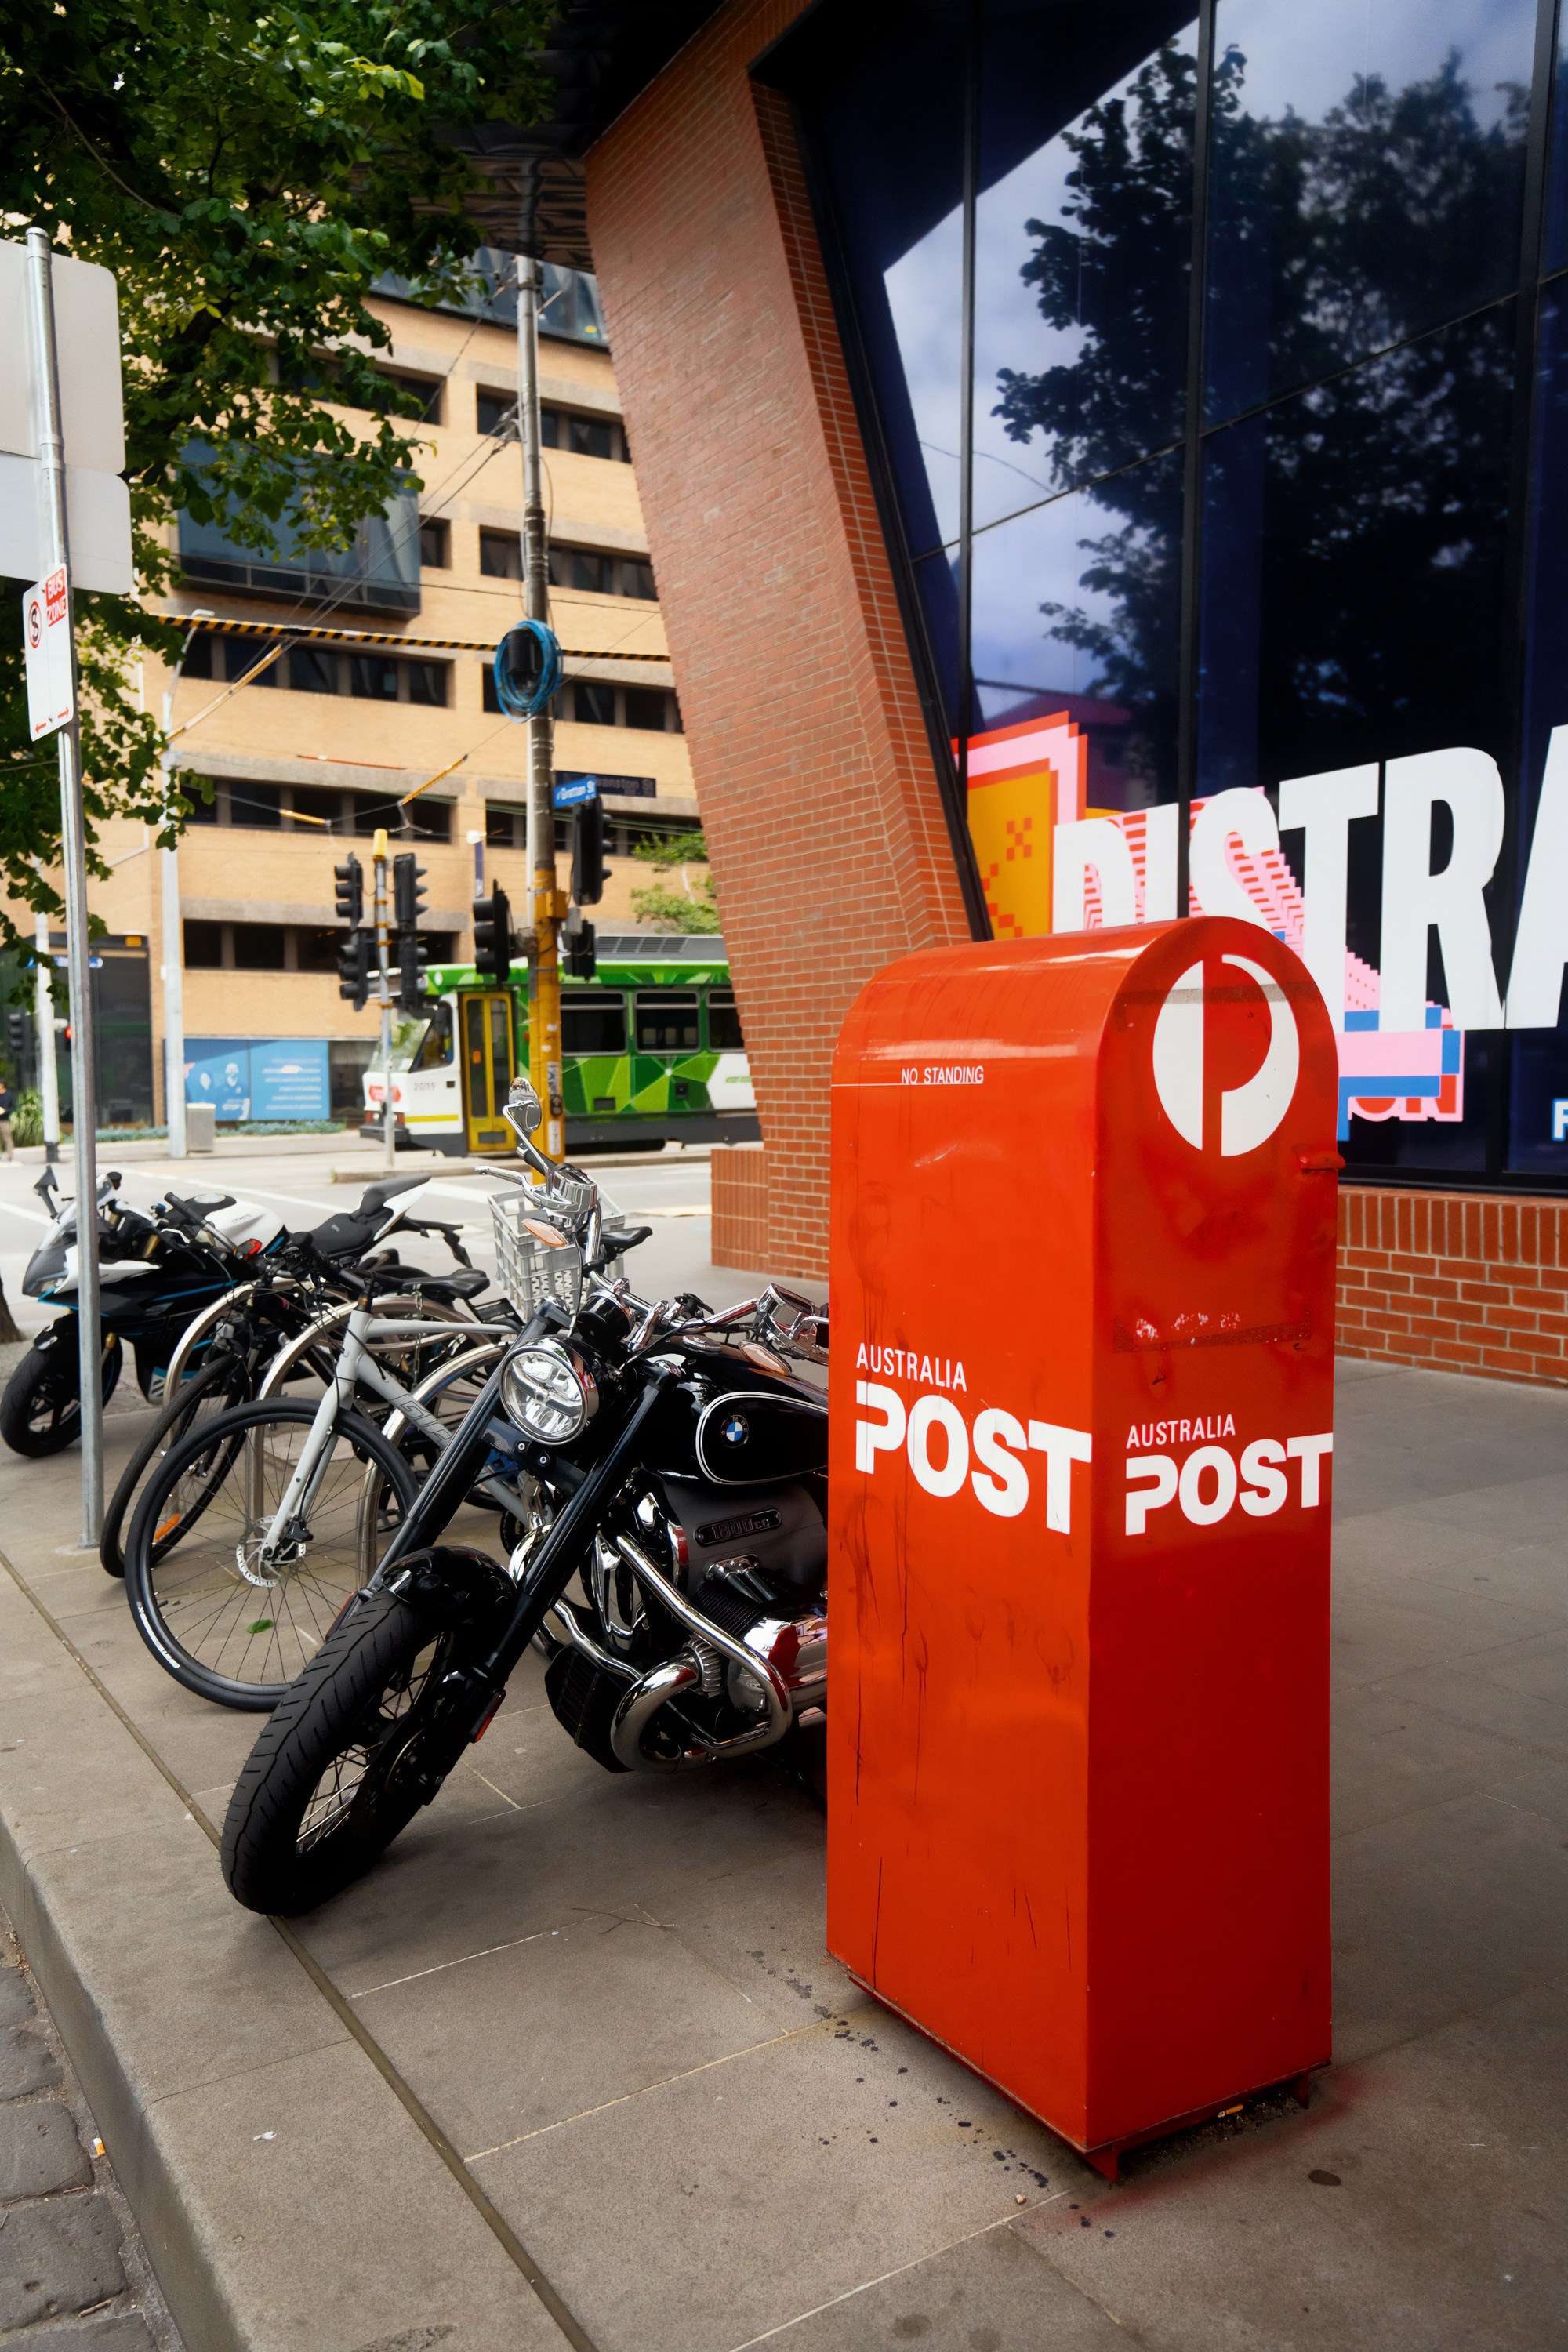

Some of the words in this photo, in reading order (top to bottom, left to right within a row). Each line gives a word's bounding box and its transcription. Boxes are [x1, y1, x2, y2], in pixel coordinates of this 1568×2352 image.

[48, 571, 64, 601] BUS
[47, 597, 67, 625] ZONE
[902, 1068, 918, 1085] NO
[924, 1065, 985, 1084] STANDING
[856, 1342, 967, 1392] AUSTRALIA
[1126, 1414, 1236, 1449] AUSTRALIA
[855, 1380, 1092, 1535] POST
[1125, 1432, 1334, 1536] POST
